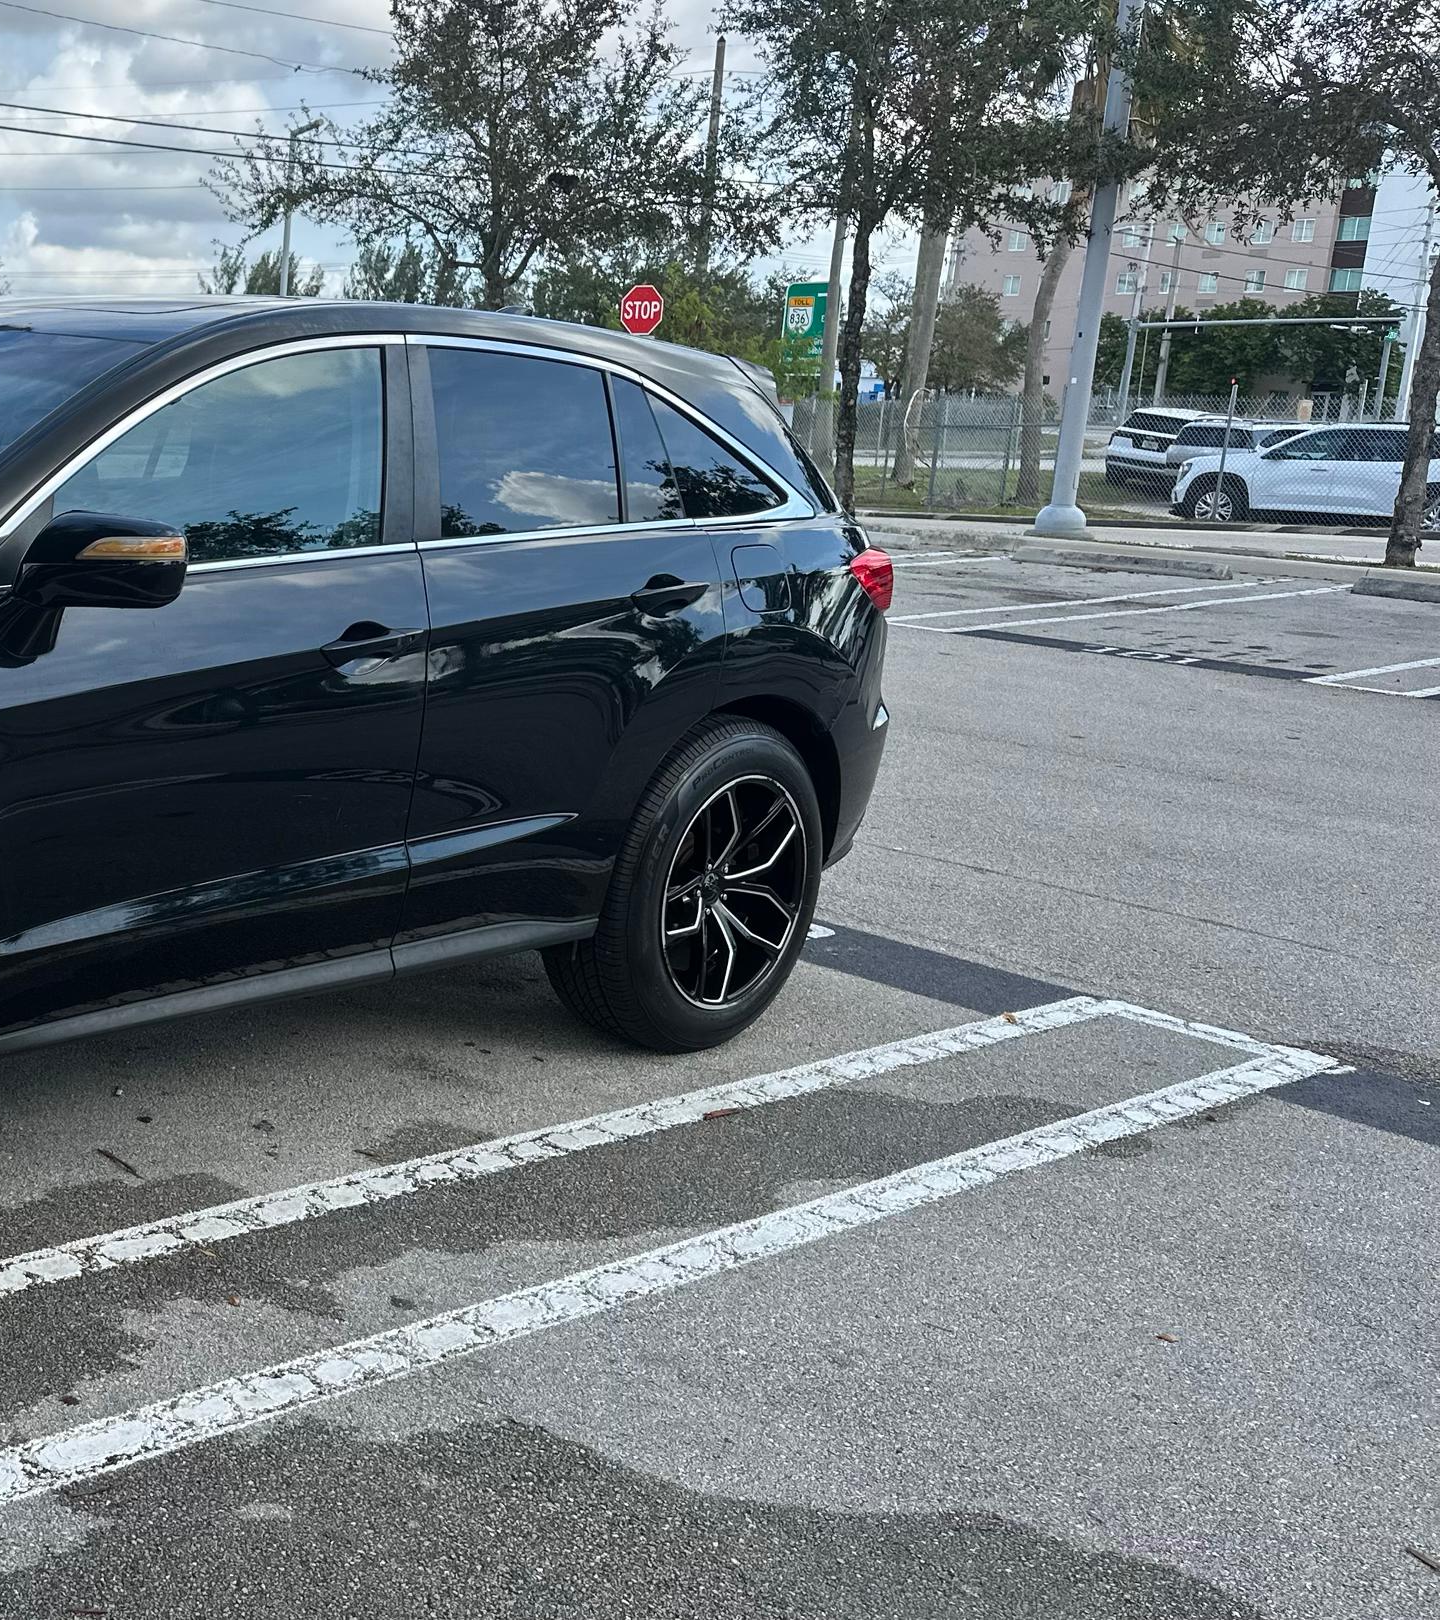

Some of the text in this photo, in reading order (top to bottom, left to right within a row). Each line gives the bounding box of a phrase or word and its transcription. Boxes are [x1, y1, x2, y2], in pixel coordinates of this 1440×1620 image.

[794, 298, 810, 306] TOLL
[624, 301, 660, 320] STOP
[789, 313, 806, 325] 836
